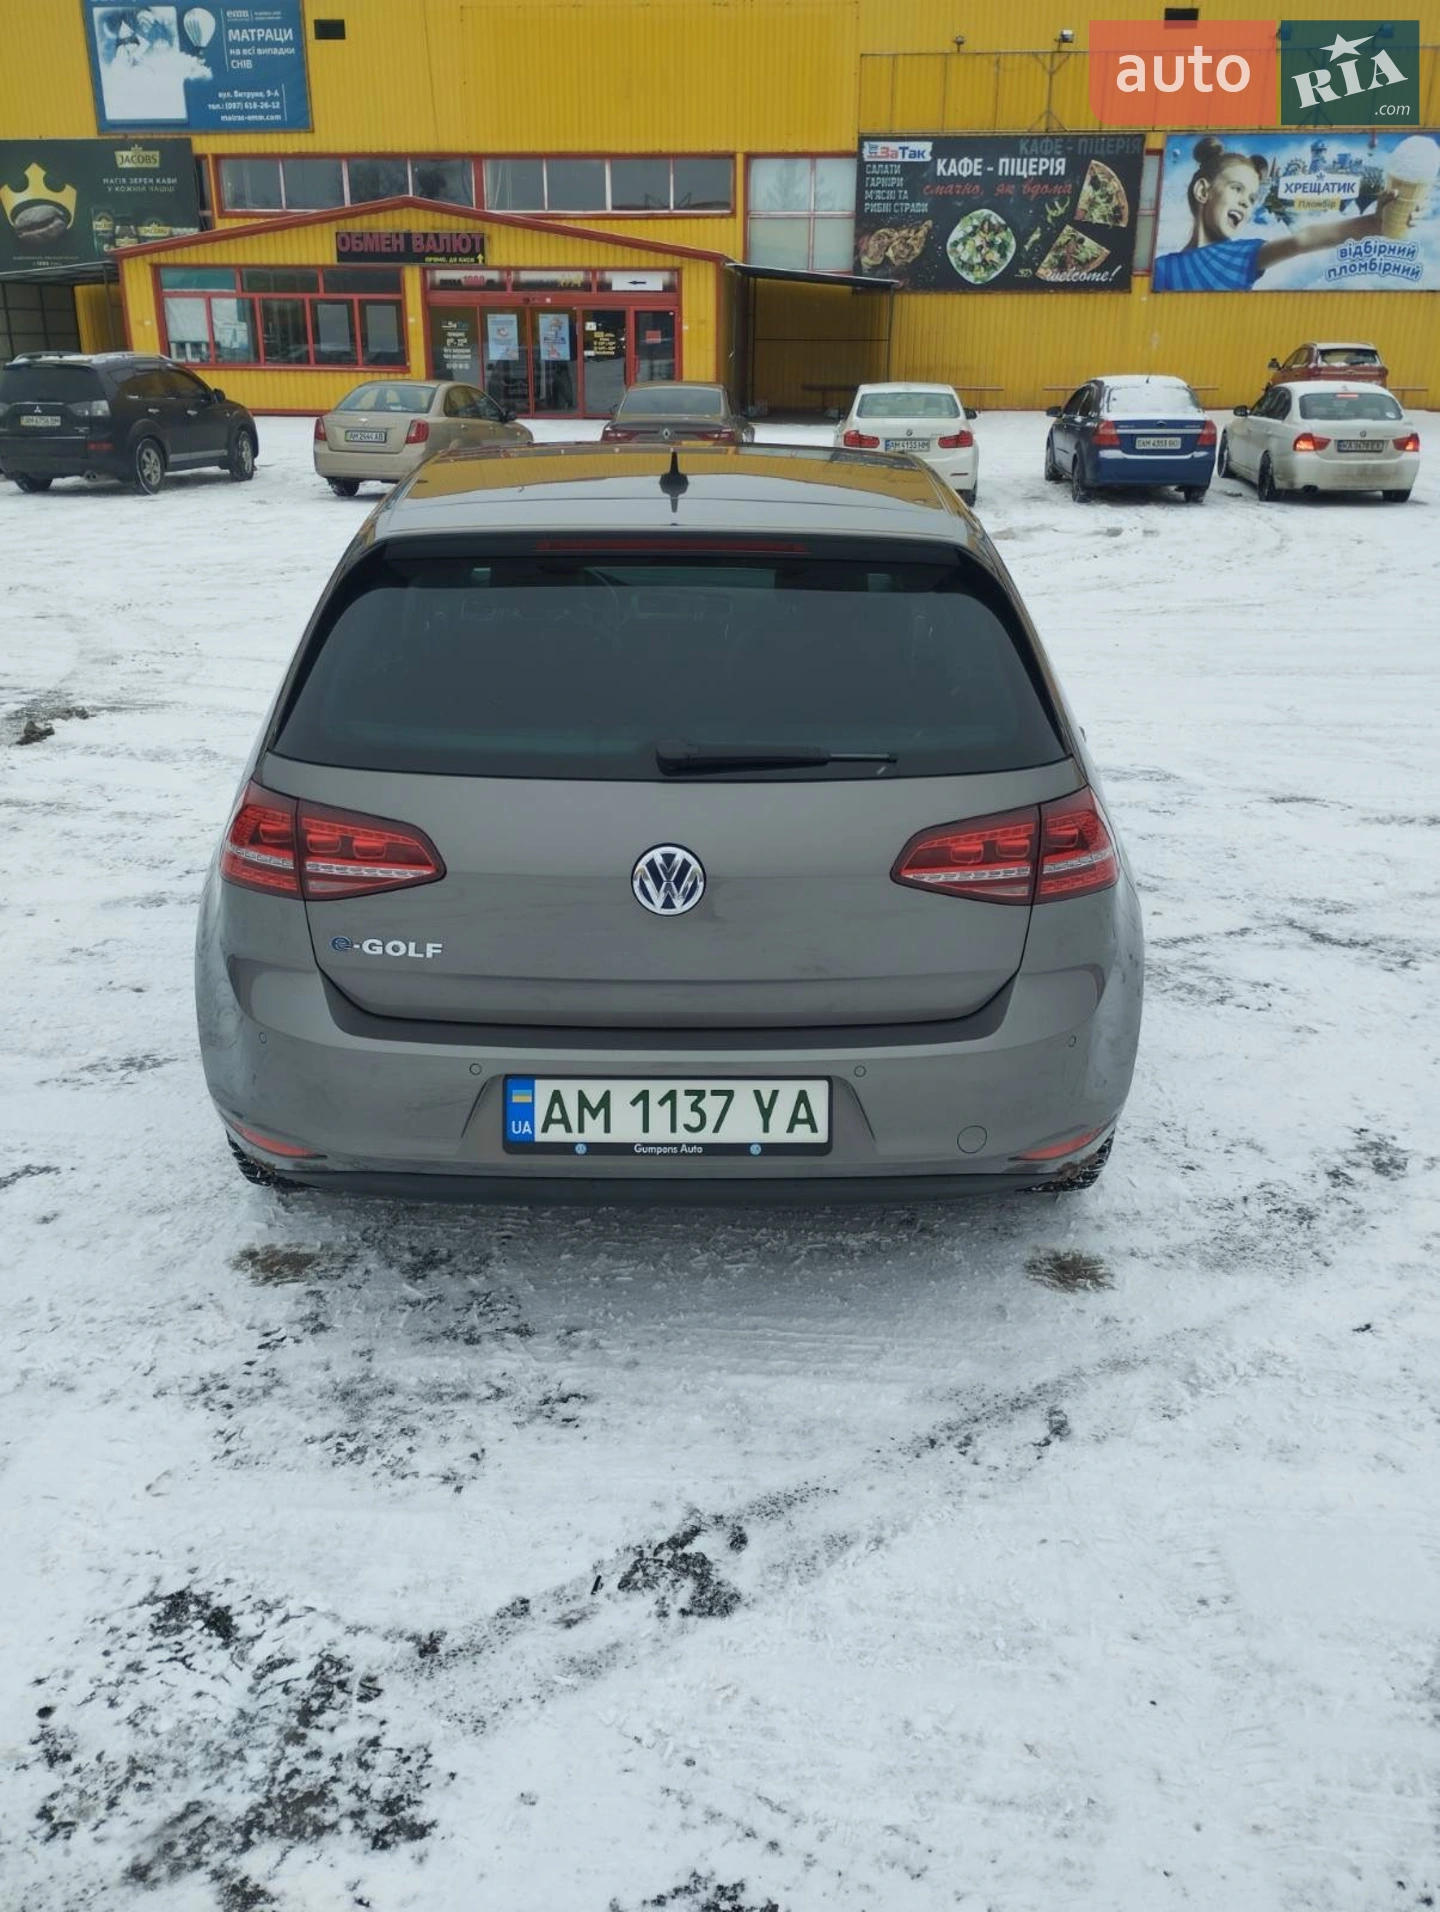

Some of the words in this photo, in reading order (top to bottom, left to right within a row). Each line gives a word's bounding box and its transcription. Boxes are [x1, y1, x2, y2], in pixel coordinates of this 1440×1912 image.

[228, 28, 294, 43] МАТРАЦИ
[242, 46, 255, 55] всі
[256, 47, 295, 56] випадки
[231, 60, 253, 69] СНІВ
[1019, 138, 1062, 155] КАФЕ
[1078, 137, 1142, 155] ПІЦЕРІЯ
[120, 155, 158, 164] JACOBS
[866, 164, 901, 174] САЛАТИ
[936, 157, 983, 177] КАФЕ
[998, 158, 1066, 178] ПІЦЕРІЯ
[865, 177, 904, 187] ГАРНІРИ
[1284, 182, 1356, 195] ХРЕЩАТИК
[898, 190, 909, 200] ТА
[864, 202, 892, 213] РИБНІ
[893, 202, 928, 213] СТРАВИ
[1298, 200, 1336, 209] Пломбір
[337, 232, 405, 252] ОБМЕН
[412, 232, 483, 253] ВАЛЮТ
[1340, 241, 1416, 260] відбірний
[1047, 265, 1122, 282] welcome!
[1327, 258, 1421, 279] пломбірний
[512, 1121, 532, 1135] UA
[540, 1089, 611, 1134] AM
[629, 1089, 735, 1134] 1137
[753, 1089, 818, 1134] YA
[680, 1143, 703, 1154] Auto
